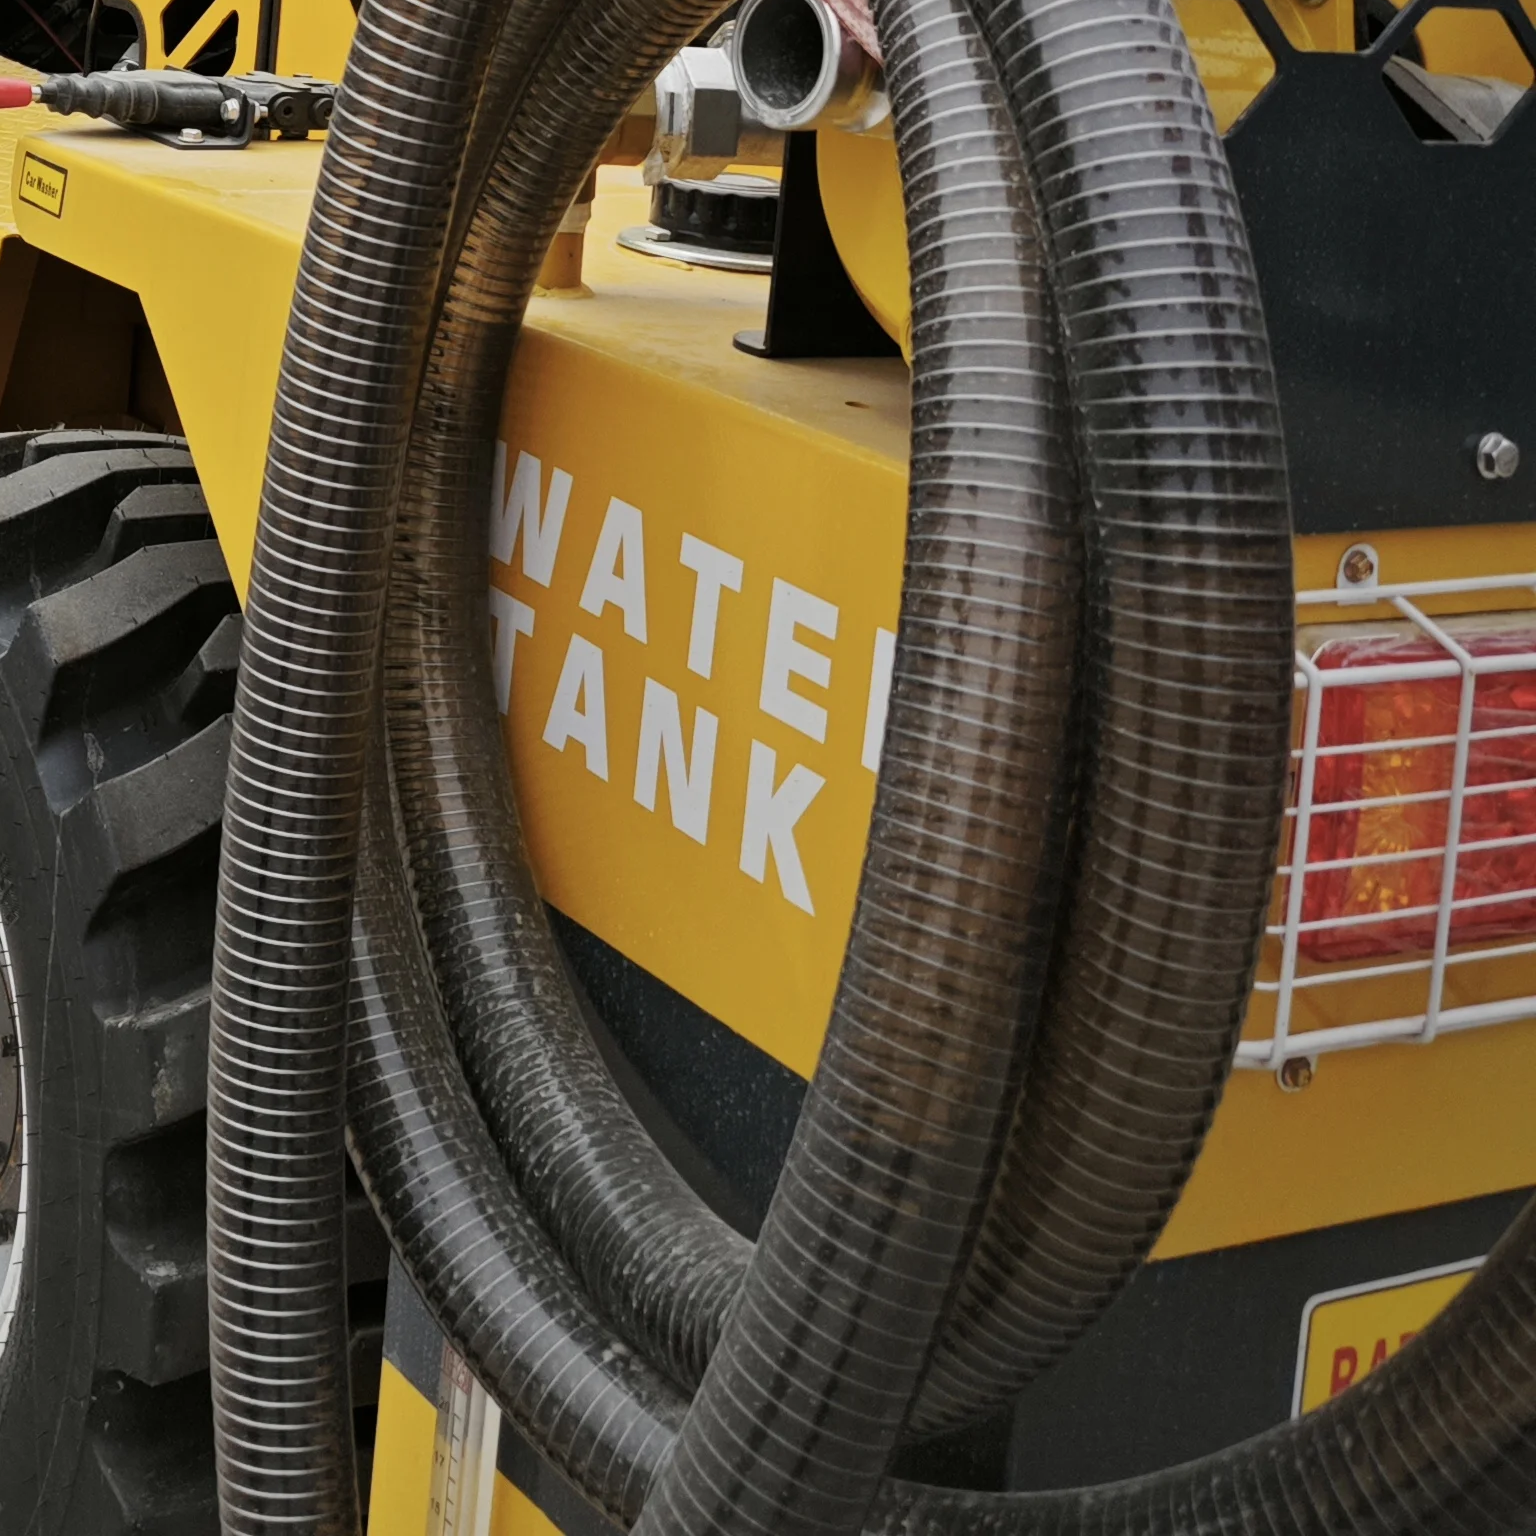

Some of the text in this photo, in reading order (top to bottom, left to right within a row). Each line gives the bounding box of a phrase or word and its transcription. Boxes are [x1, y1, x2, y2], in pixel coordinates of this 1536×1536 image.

[26, 171, 58, 199] Car Washer
[488, 585, 826, 918] TANK
[1330, 1332, 1417, 1397] RA
[434, 1451, 445, 1467] 17
